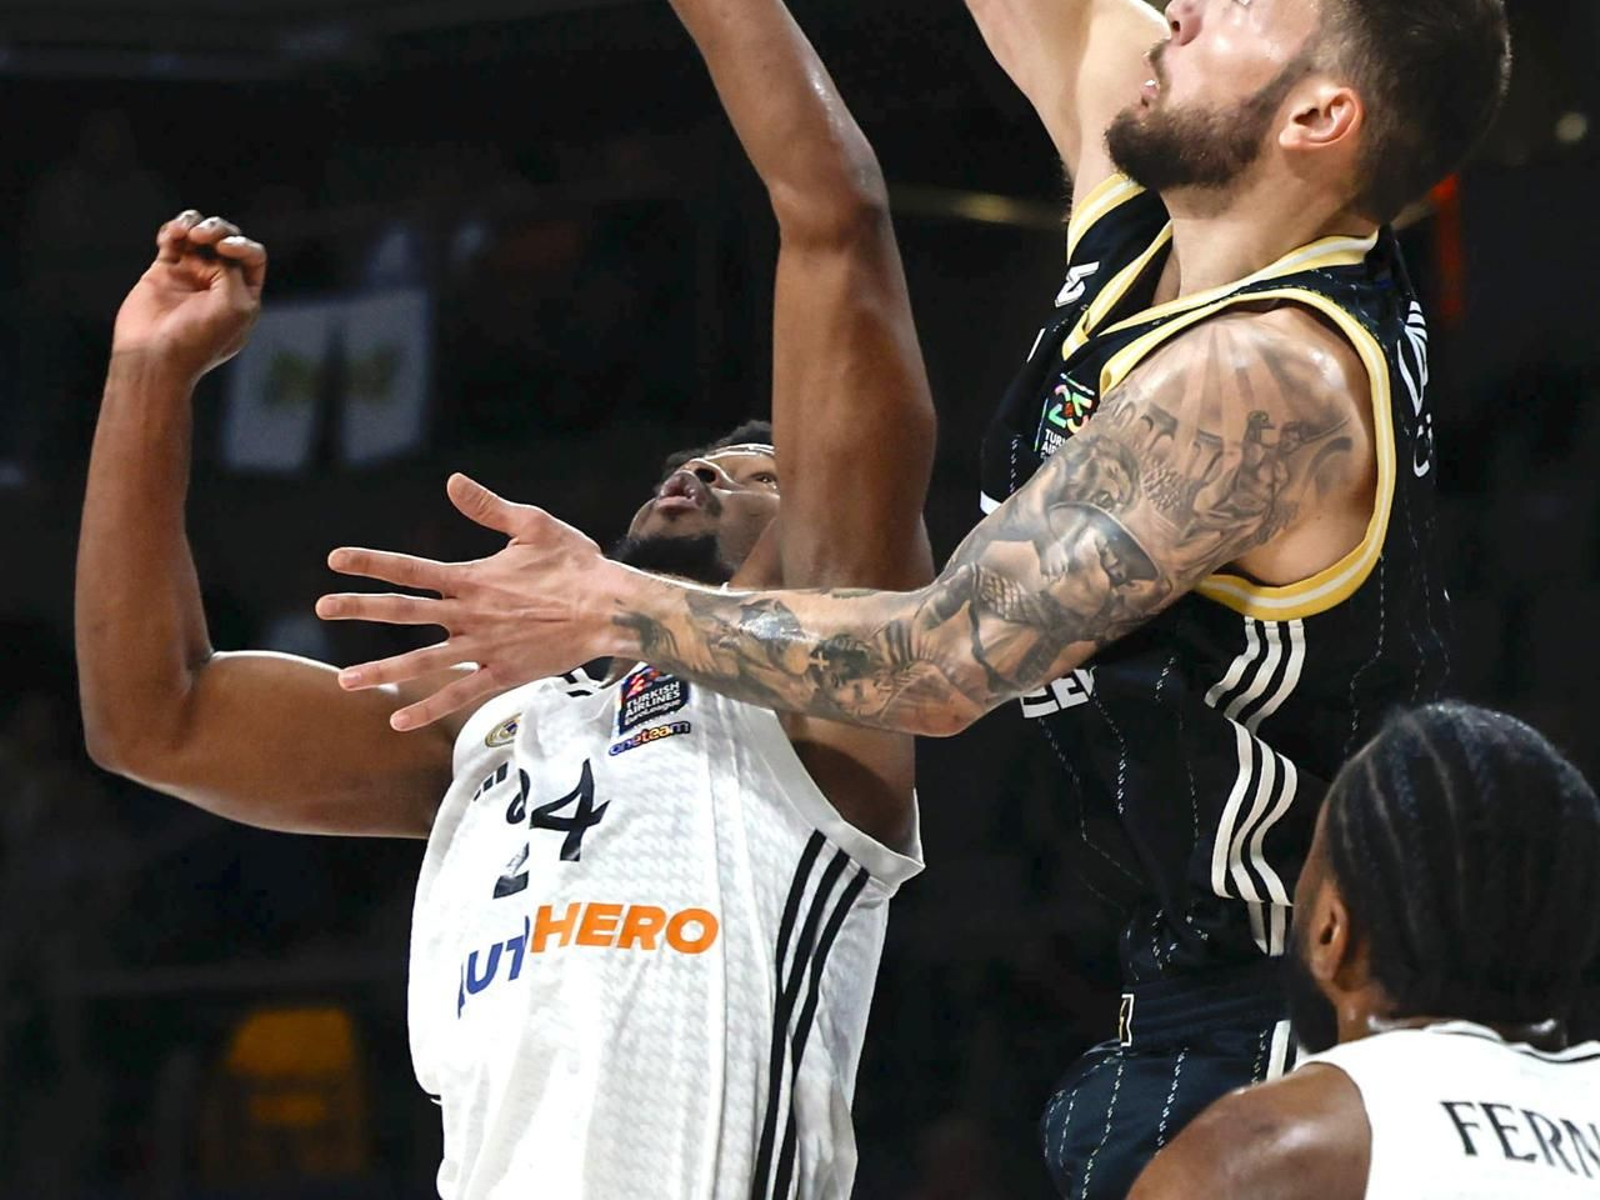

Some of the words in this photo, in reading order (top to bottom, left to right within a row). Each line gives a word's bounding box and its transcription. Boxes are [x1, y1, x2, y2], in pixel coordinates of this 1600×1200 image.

[625, 689, 681, 718] AIRLINES
[626, 680, 680, 711] TURKISH
[457, 902, 720, 1021] UTHERO
